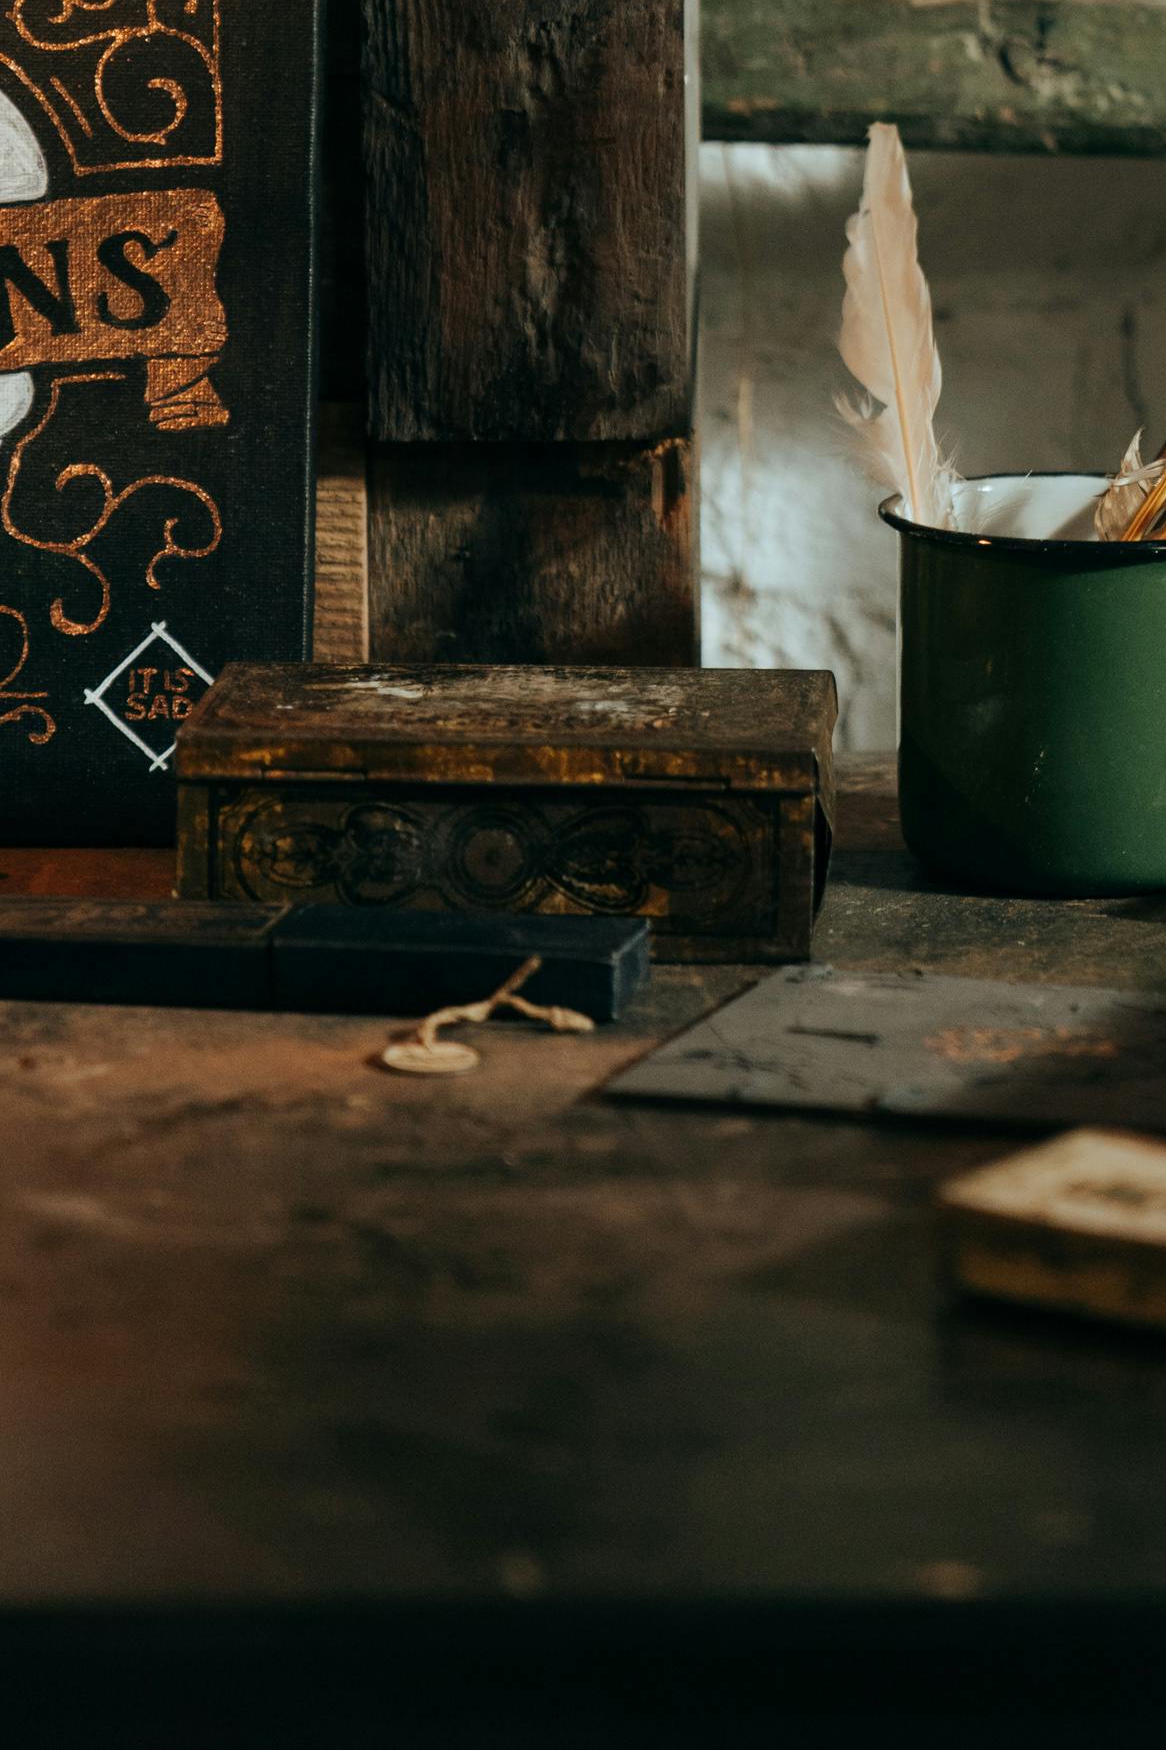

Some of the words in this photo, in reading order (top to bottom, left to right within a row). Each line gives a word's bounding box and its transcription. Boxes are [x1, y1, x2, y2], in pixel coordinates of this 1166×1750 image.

[128, 667, 158, 694] IT
[163, 667, 195, 693] IS
[124, 692, 194, 721] SAD
